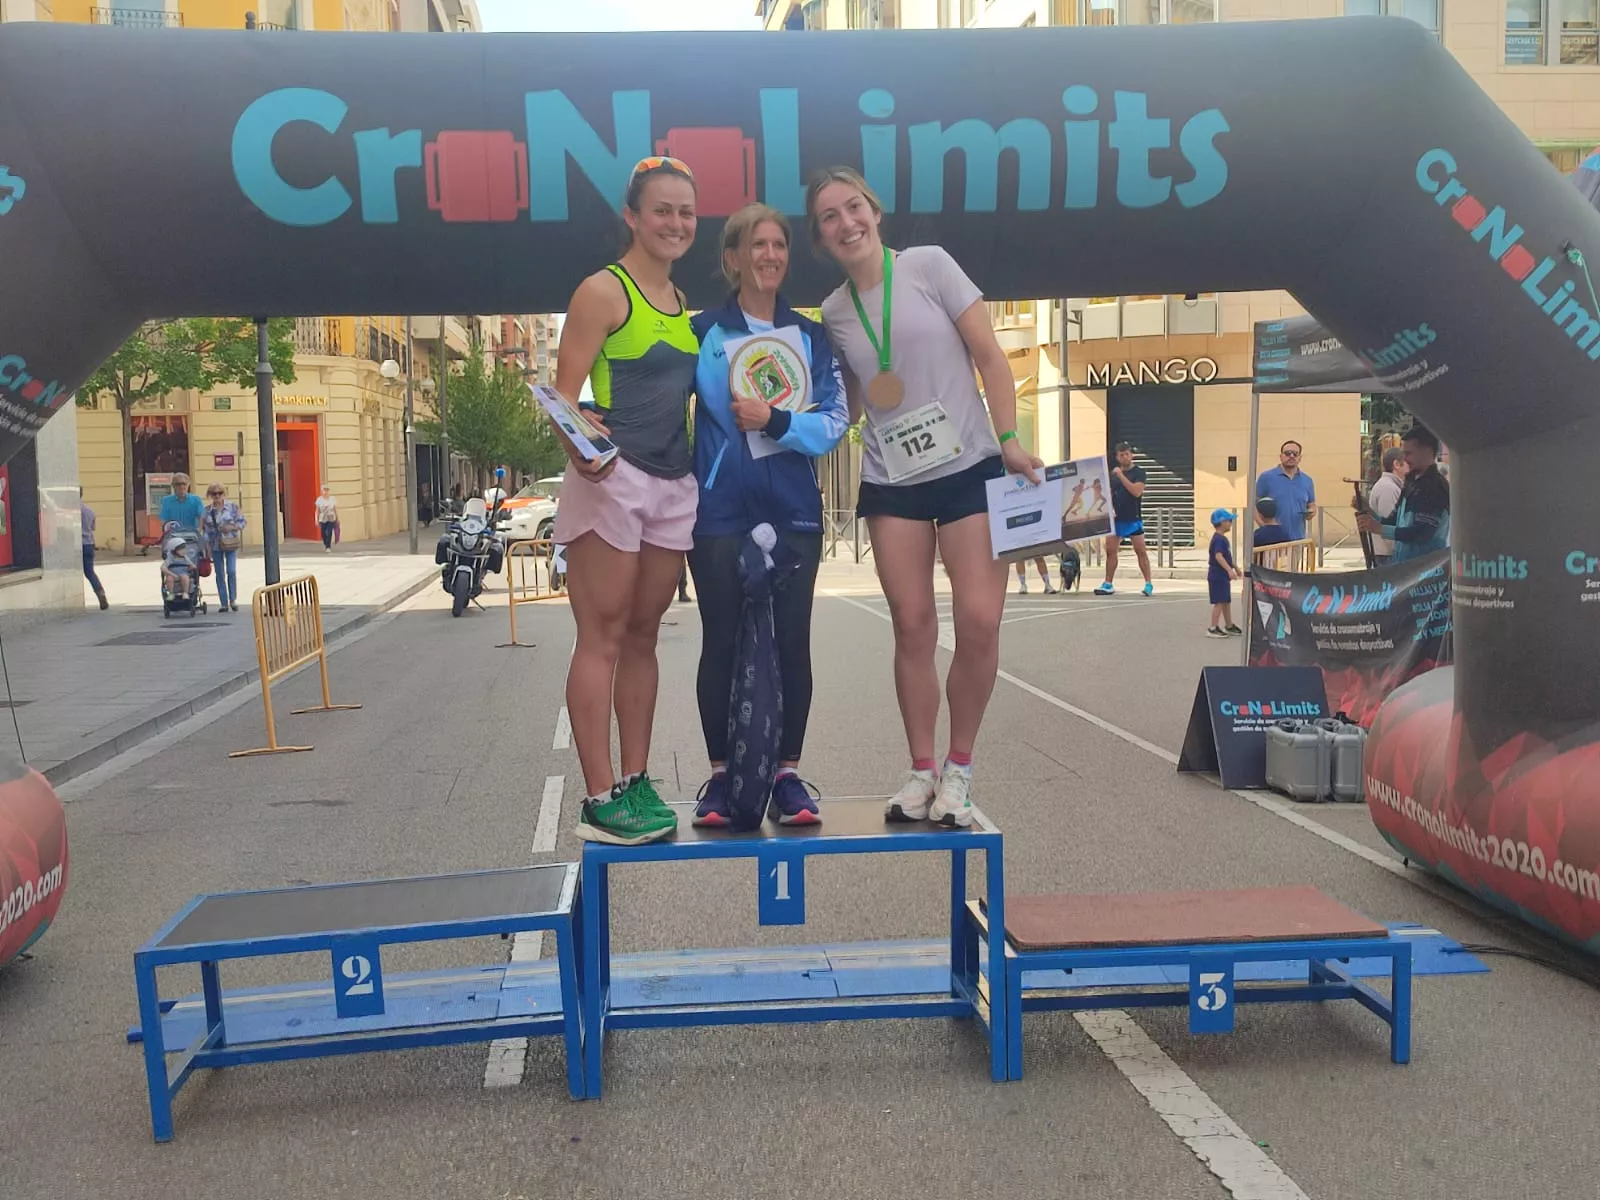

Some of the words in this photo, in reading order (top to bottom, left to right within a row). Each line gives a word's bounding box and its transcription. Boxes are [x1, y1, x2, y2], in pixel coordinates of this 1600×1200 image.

[1087, 357, 1217, 387] MANGO
[901, 432, 936, 457] 112
[770, 861, 790, 900] 1
[341, 955, 374, 997] 2
[1198, 973, 1227, 1011] 3
